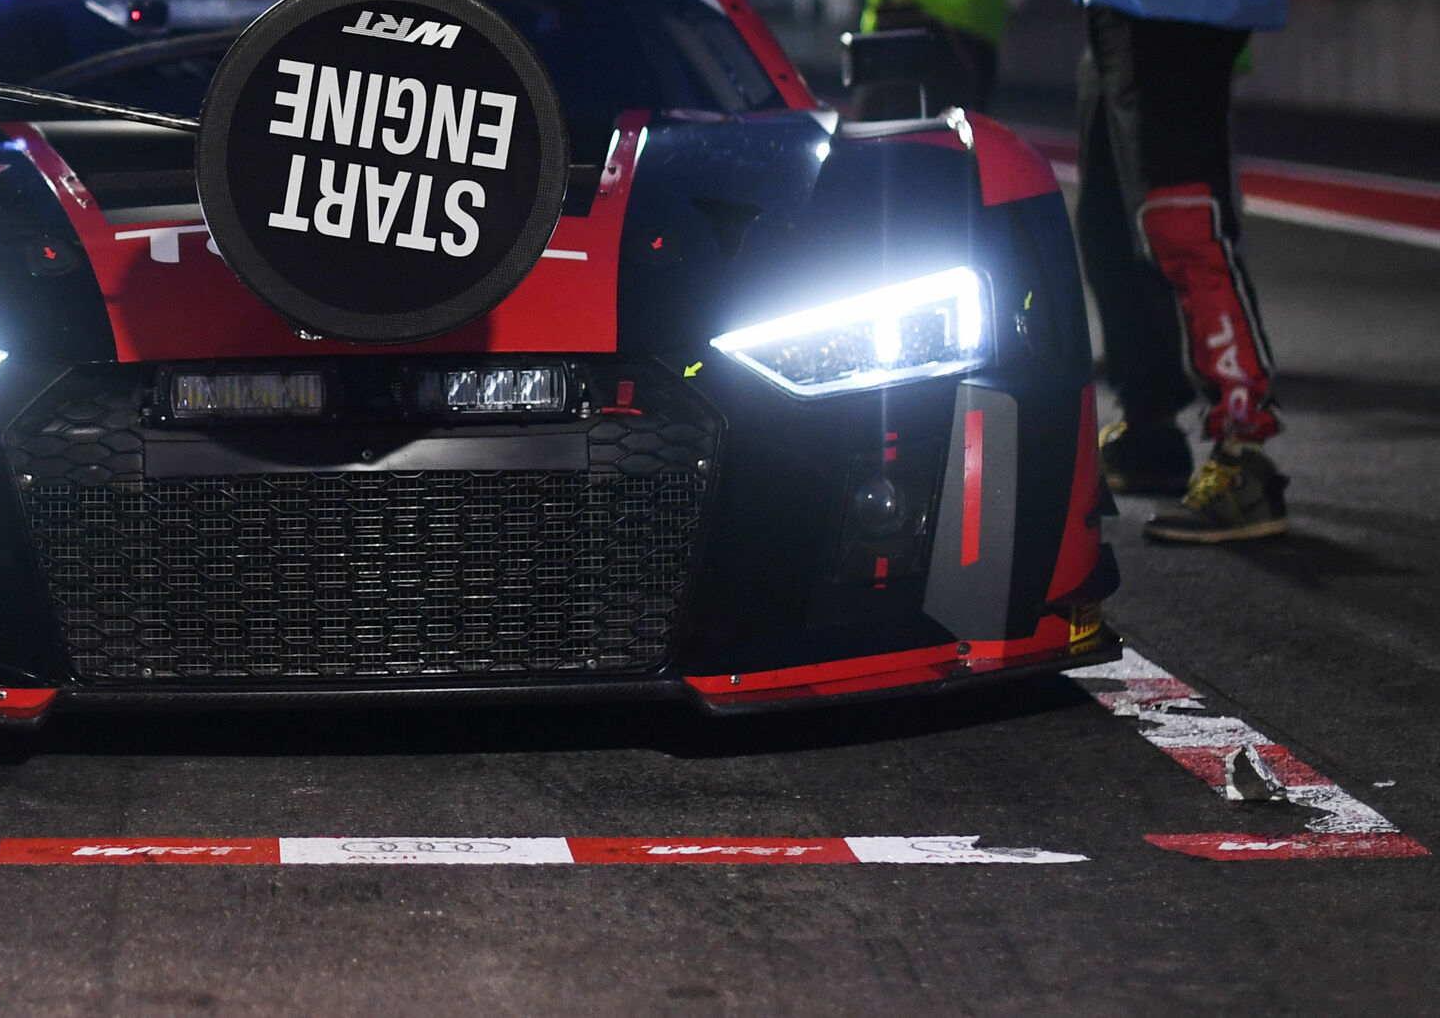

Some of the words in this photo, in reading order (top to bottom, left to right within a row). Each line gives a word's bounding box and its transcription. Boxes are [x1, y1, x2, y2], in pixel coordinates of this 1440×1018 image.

[341, 11, 462, 49] WRT
[269, 59, 517, 170] ENGINE
[268, 154, 486, 257] START
[71, 845, 252, 856] WRT
[646, 845, 823, 856] WRT
